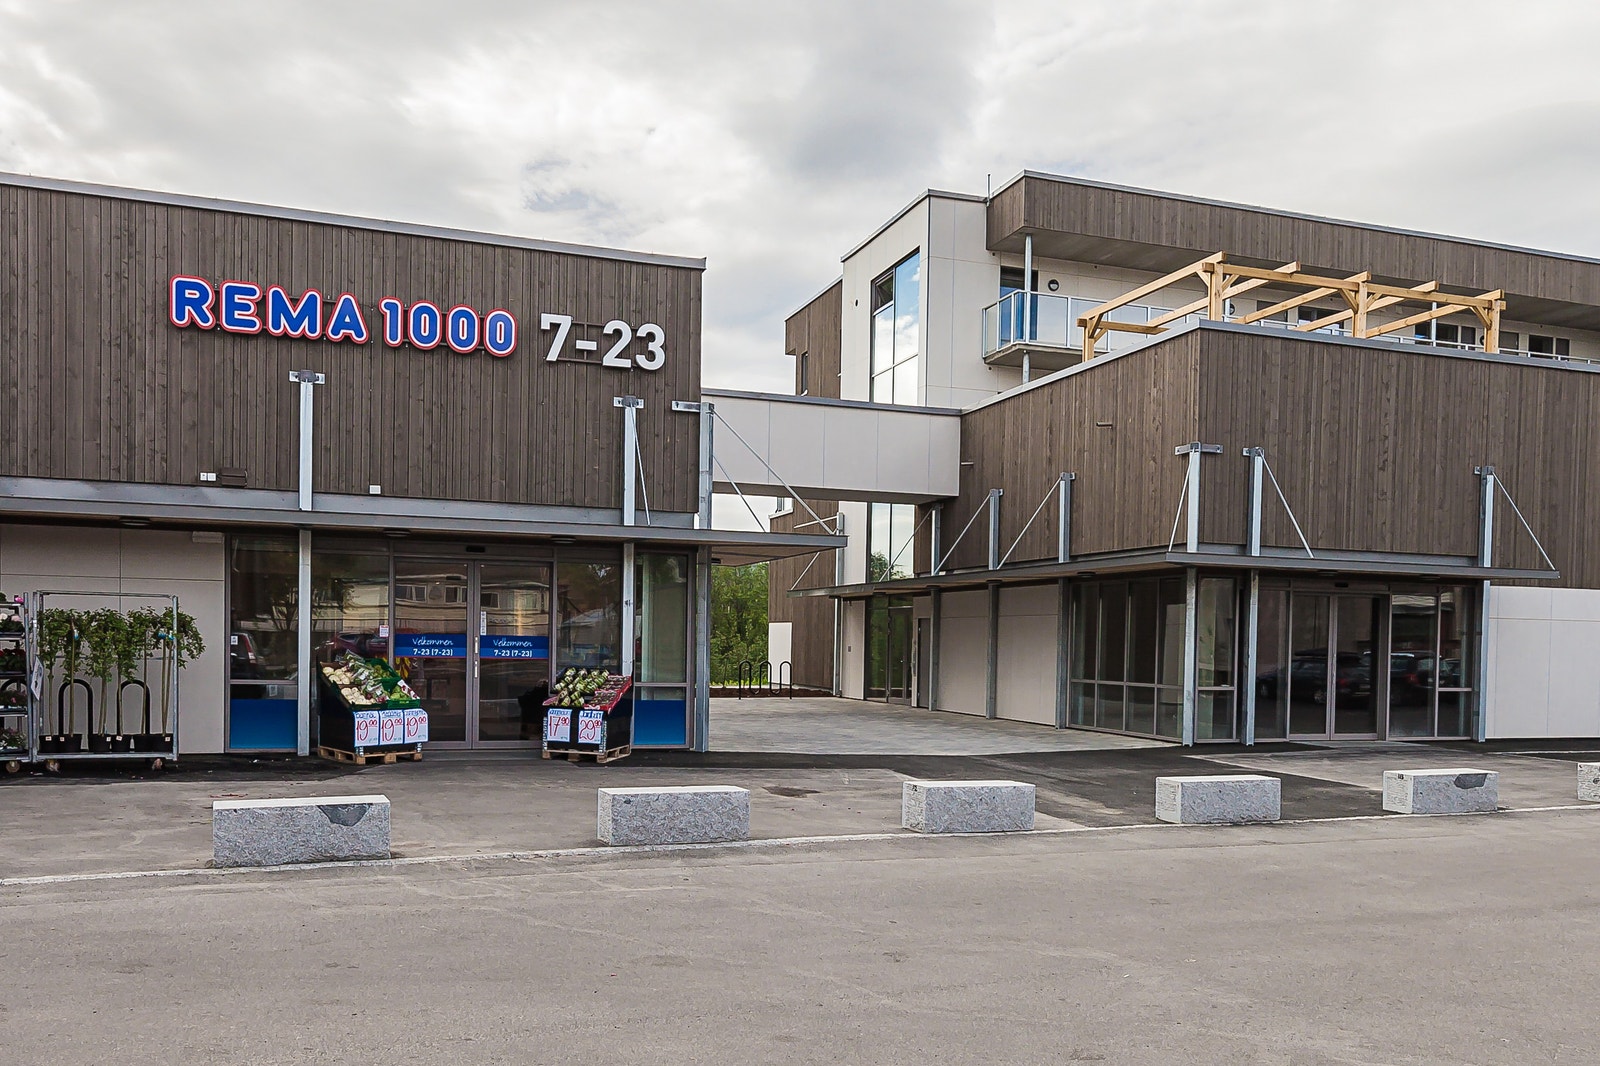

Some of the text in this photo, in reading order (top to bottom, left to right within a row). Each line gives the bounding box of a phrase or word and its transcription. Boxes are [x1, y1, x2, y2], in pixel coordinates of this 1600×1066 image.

[169, 275, 519, 358] REMA 1000
[540, 313, 666, 371] 7-23
[412, 636, 454, 646] Velkommen
[493, 637, 533, 647] Velkommen
[413, 648, 430, 656] 7-23
[493, 649, 510, 657] 7-23
